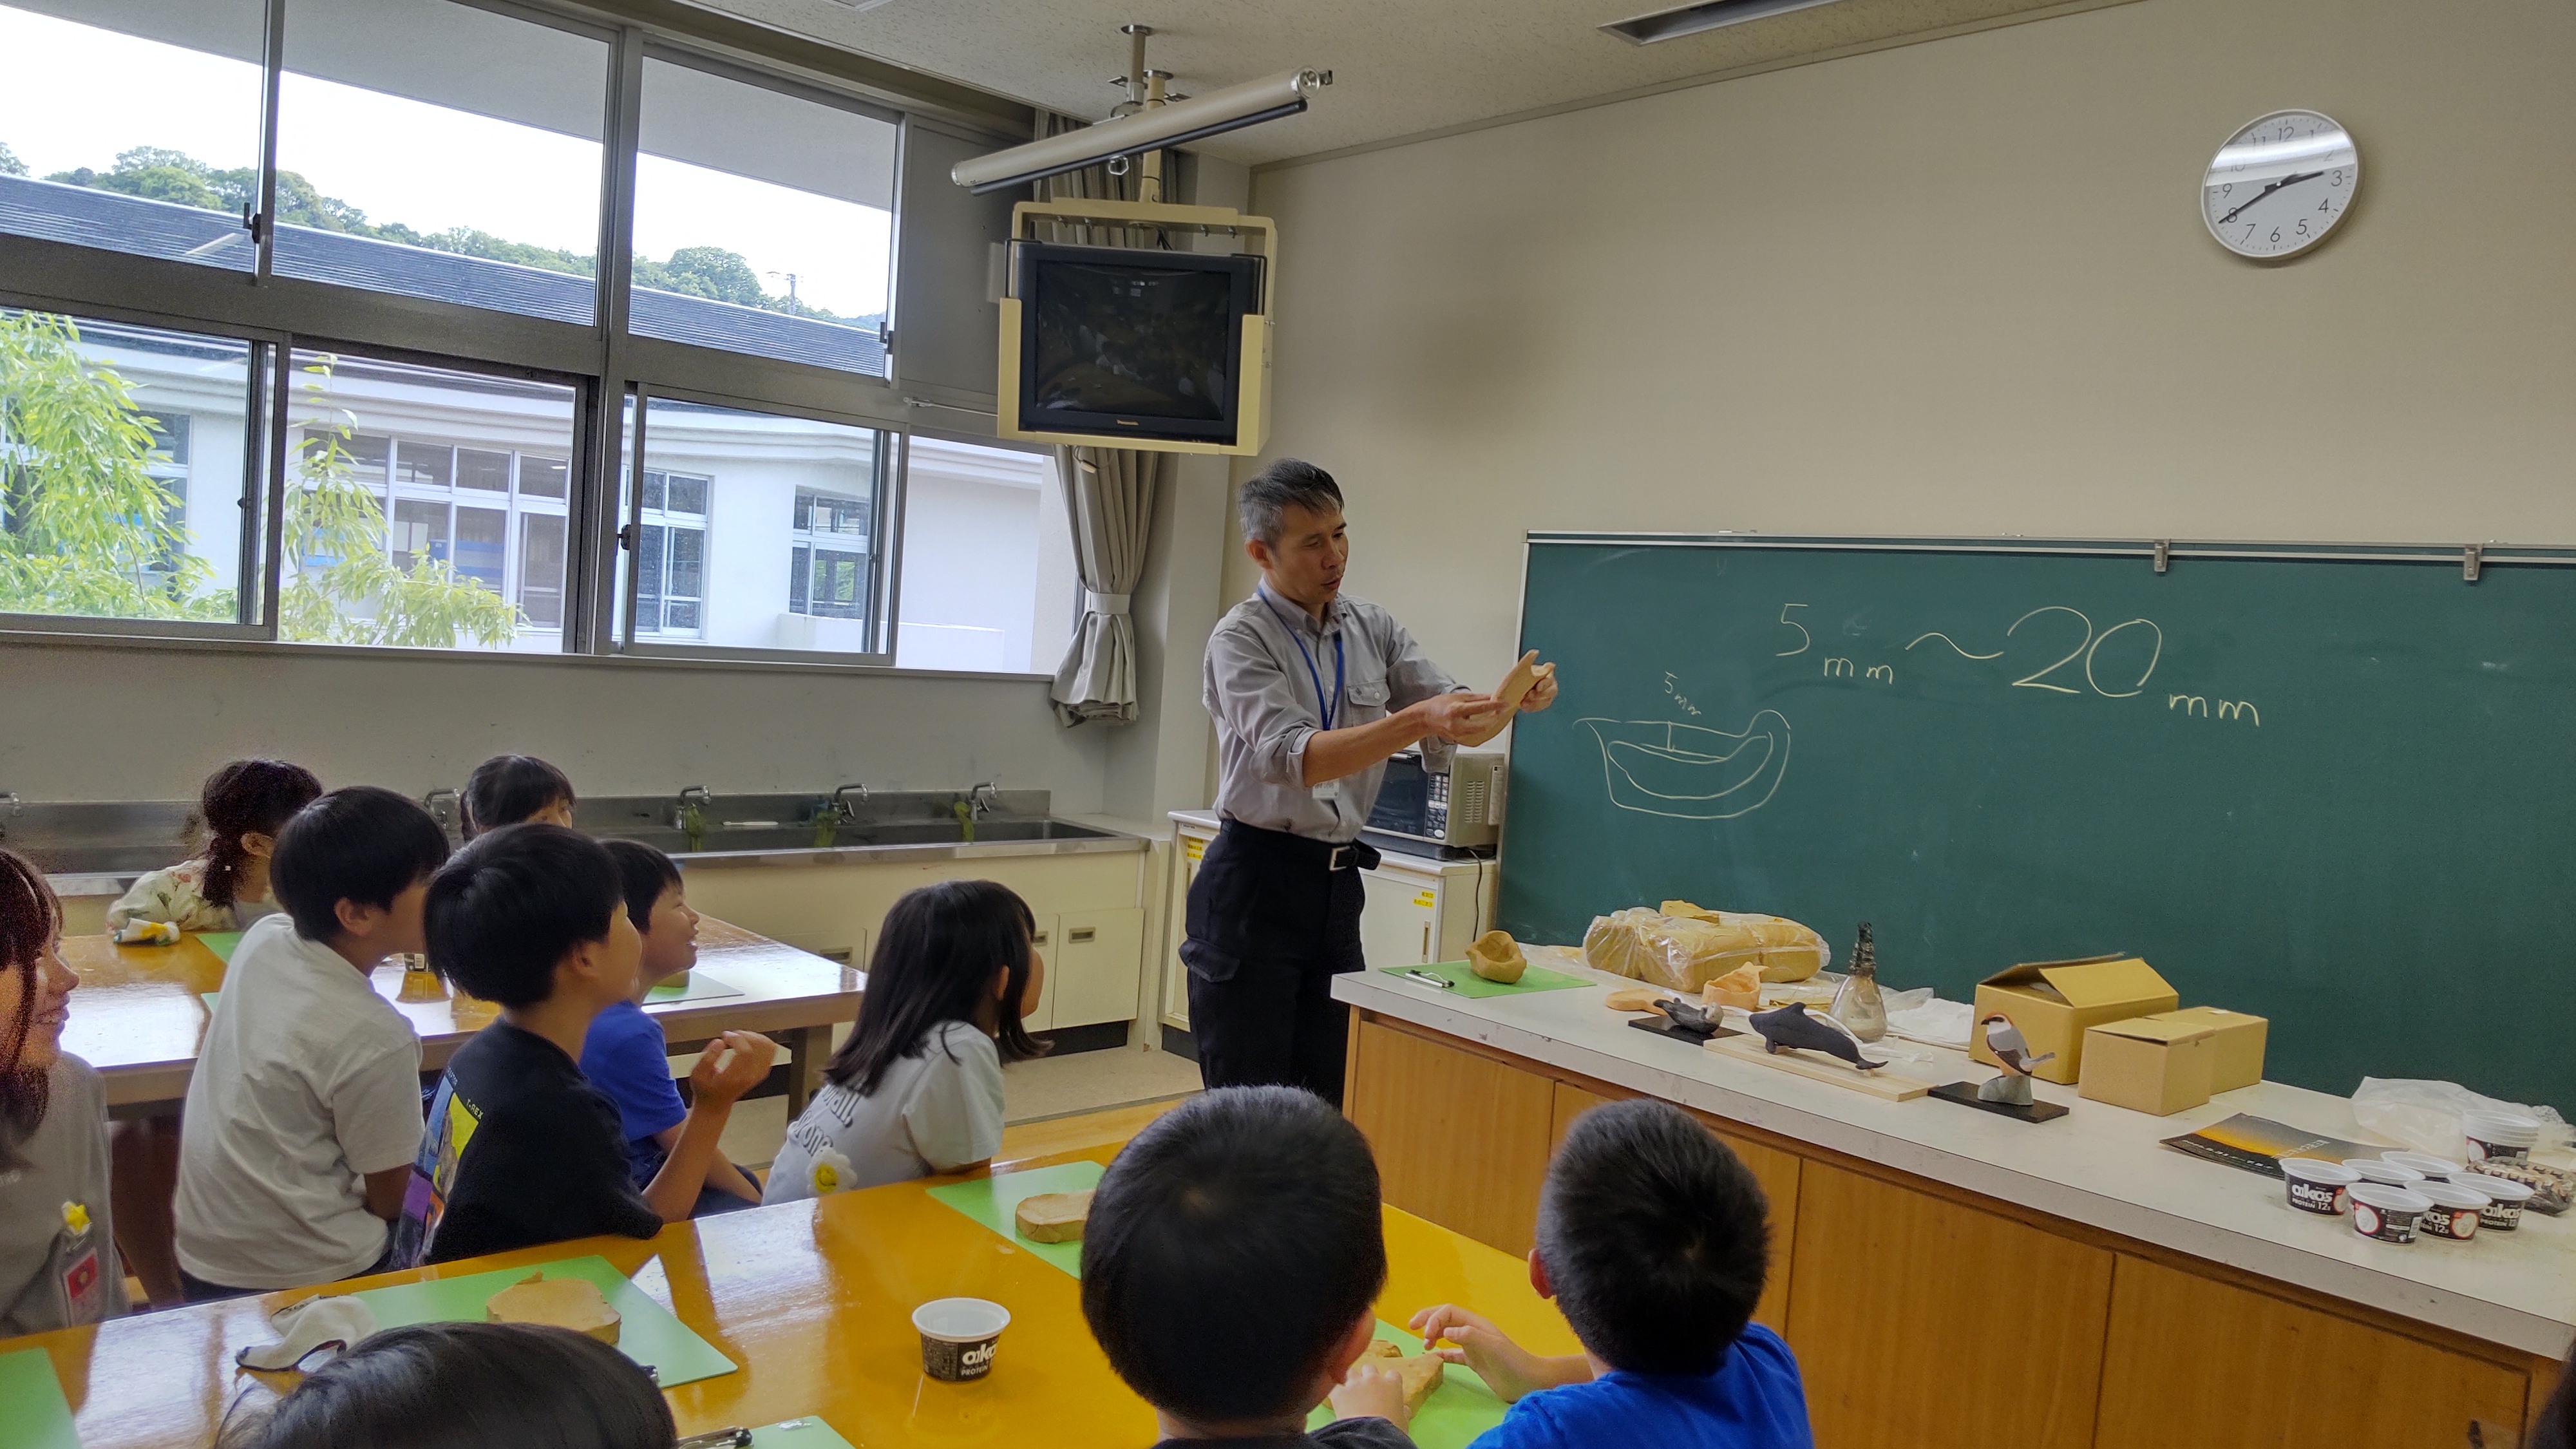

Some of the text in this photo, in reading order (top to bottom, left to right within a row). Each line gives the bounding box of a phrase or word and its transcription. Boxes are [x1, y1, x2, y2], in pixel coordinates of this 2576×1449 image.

[2278, 126, 2295, 142] 12
[2331, 170, 2343, 187] 3
[2222, 183, 2233, 199] 9
[2318, 198, 2329, 214] 4
[2226, 207, 2238, 223] 8
[2245, 223, 2256, 240] 7
[2270, 225, 2280, 242] 6
[2295, 219, 2308, 235] 5
[961, 1343, 998, 1365] oiko
